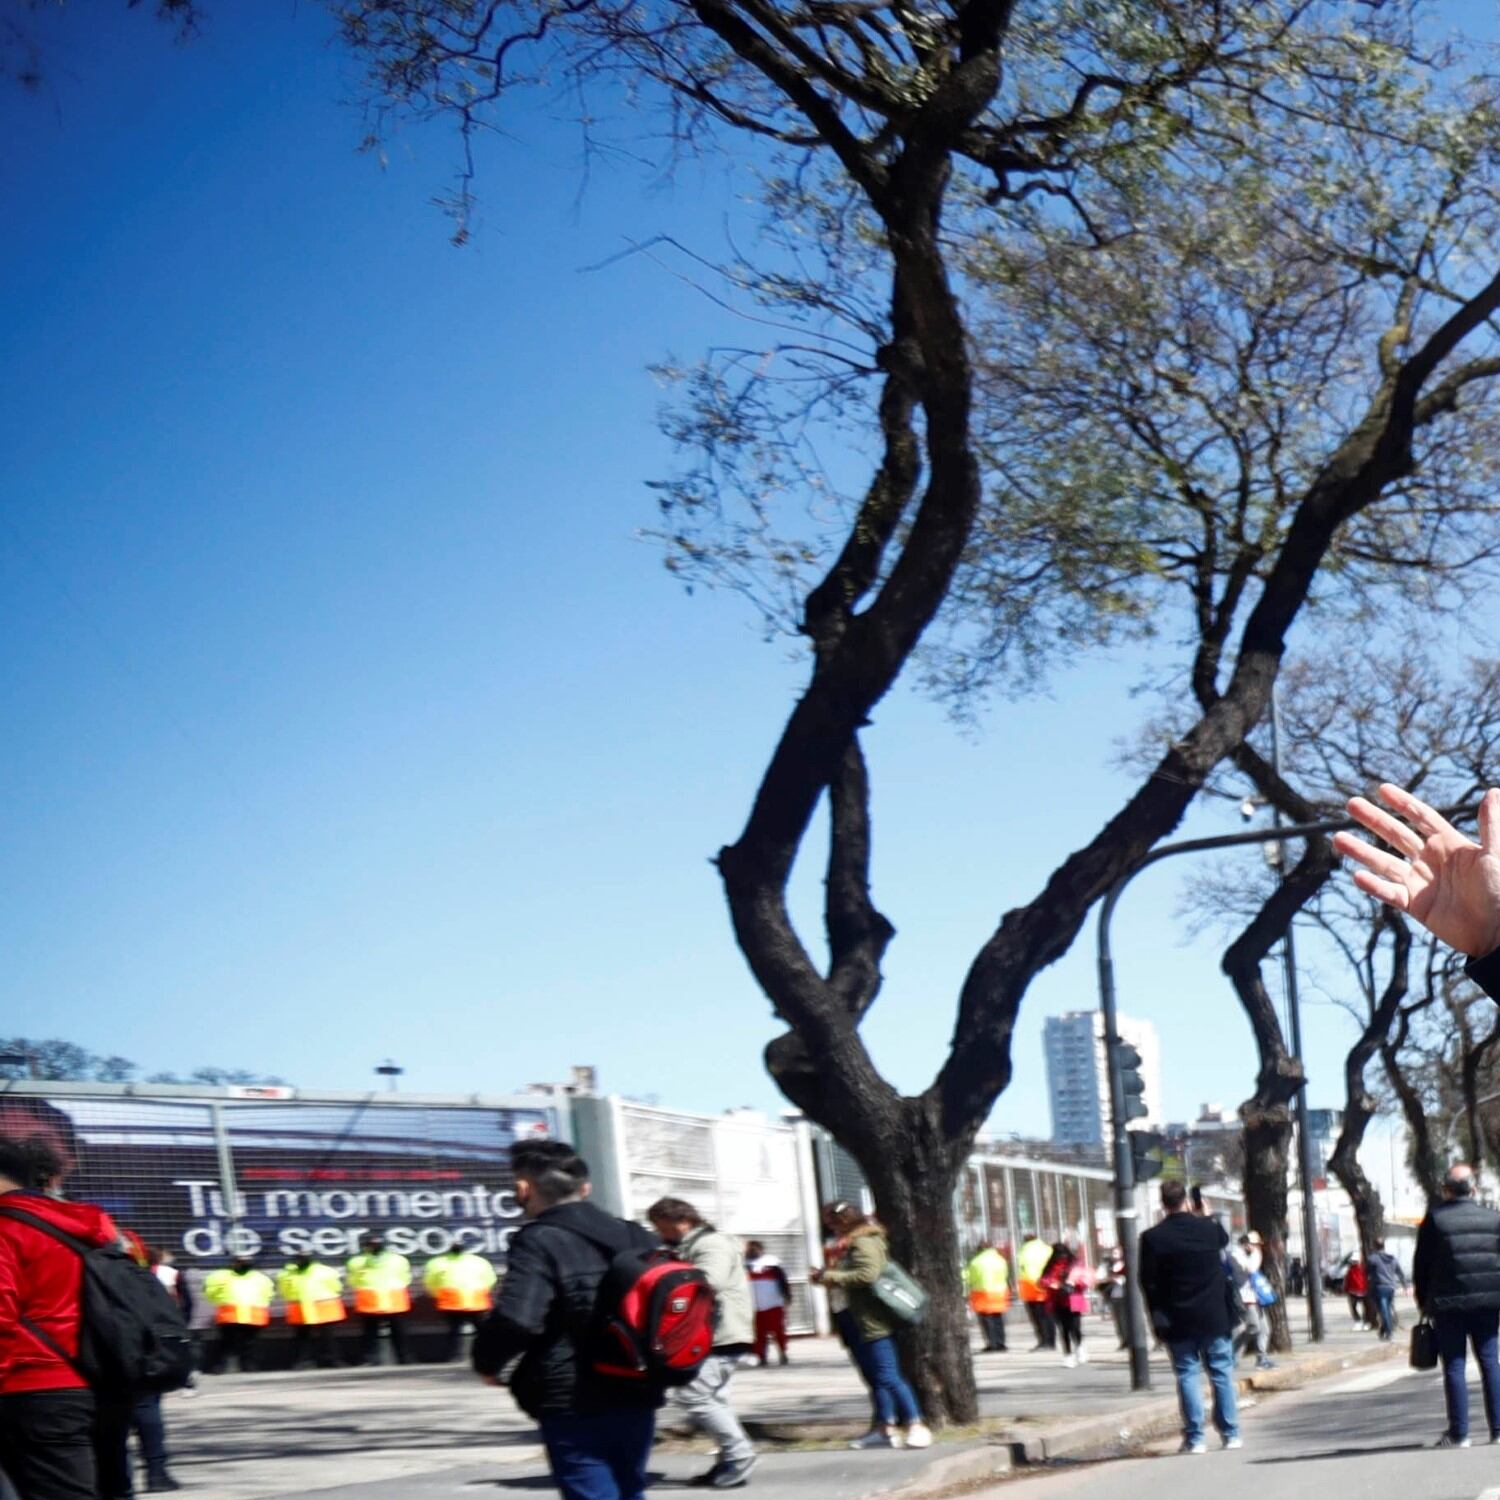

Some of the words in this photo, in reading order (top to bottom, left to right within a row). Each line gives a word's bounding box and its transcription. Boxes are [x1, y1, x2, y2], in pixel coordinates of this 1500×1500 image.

[173, 1180, 247, 1217] Tu
[183, 1219, 262, 1256] de
[278, 1226, 370, 1256] ser
